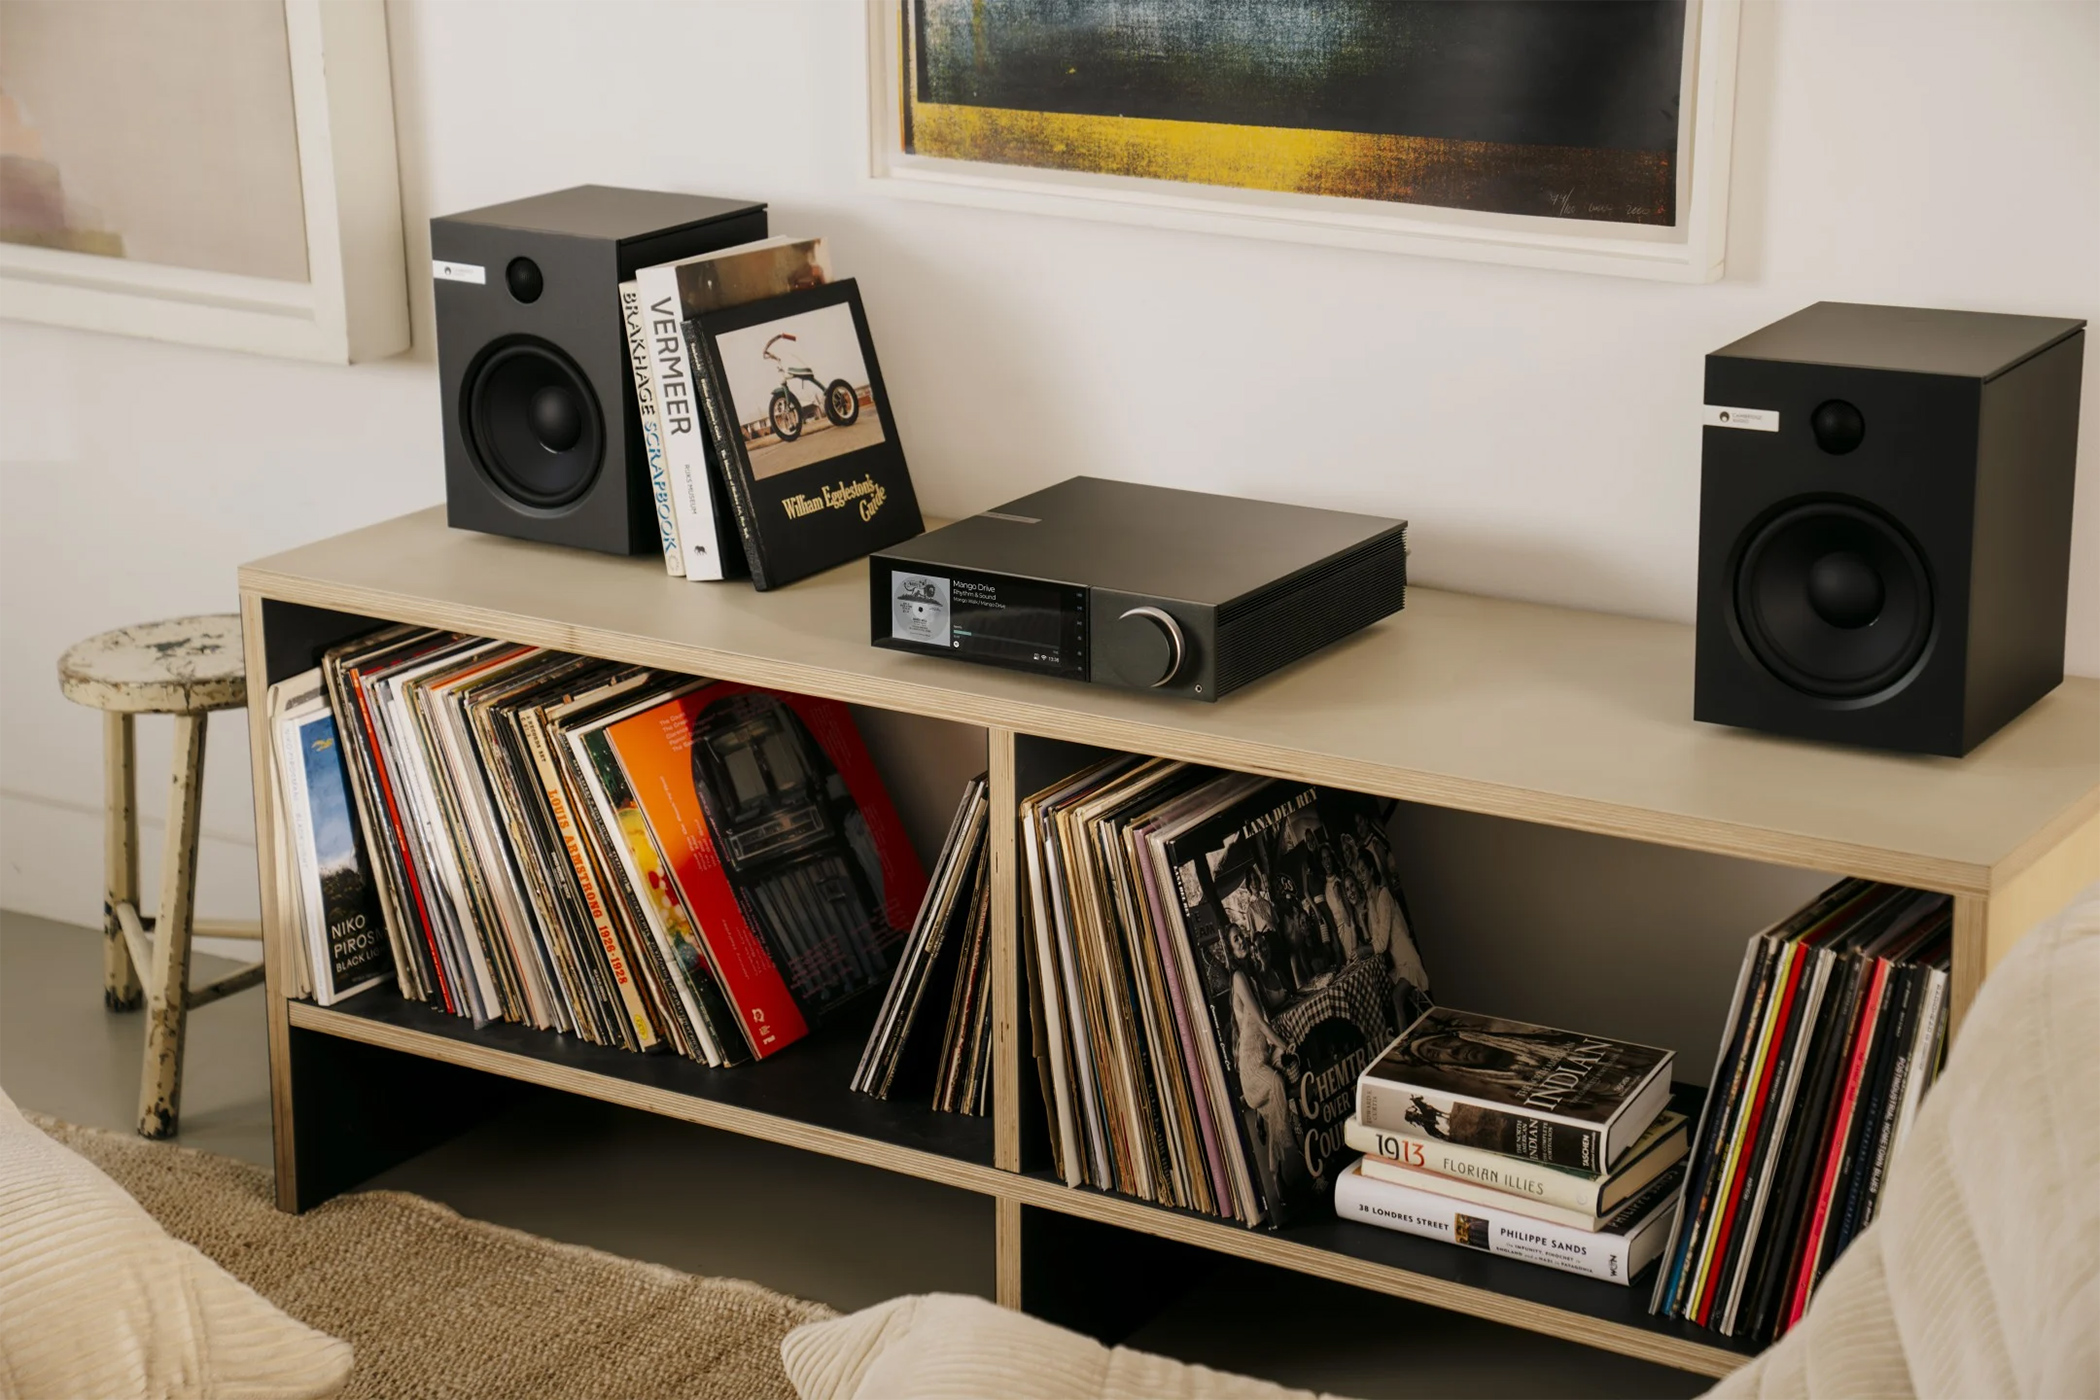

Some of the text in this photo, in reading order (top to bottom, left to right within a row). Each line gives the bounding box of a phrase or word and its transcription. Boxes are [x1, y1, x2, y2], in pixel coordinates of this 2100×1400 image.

[650, 296, 692, 435] VERMEER
[623, 293, 677, 553] BRAKHAGE SCRAPBOOK
[688, 484, 698, 514] MUSEUM
[782, 474, 875, 520] William Eggleston's
[859, 484, 887, 522] Guide
[953, 580, 996, 593] Mango Drive
[953, 589, 974, 600] Rhythm
[979, 592, 997, 601] Sound
[1242, 786, 1317, 839] LANA DEL REY
[546, 788, 570, 829] LOUIS
[561, 832, 605, 918] ARMSTRONG
[1173, 865, 1190, 917] LANA DEL REY
[331, 914, 366, 939] NIKO
[336, 947, 380, 973] BLACK LIG
[1524, 1038, 1613, 1111] INDIAN
[1884, 1055, 1906, 1121] POSTINDUSTRIAL
[1323, 1091, 1351, 1123] OVER
[1514, 1119, 1523, 1142] NORTH
[1518, 1123, 1530, 1153] AMERICAN
[1524, 1118, 1543, 1160] INDIAN
[1874, 1121, 1892, 1167] HOMETOWN
[1304, 1124, 1346, 1178] COU
[1376, 1134, 1425, 1167] 1913
[1579, 1133, 1592, 1166] TASCHEN
[1443, 1158, 1544, 1195] FLORIAN ILLIES
[1742, 1176, 1753, 1201] REQUIEM
[1868, 1166, 1882, 1193] BLUES
[1359, 1204, 1450, 1231] 38 LONDRES STREET
[1500, 1228, 1587, 1256] PHILIPPE SANDS
[1545, 1251, 1574, 1261] PINOCHET
[1496, 1246, 1523, 1257] ENGLAND
[1561, 1262, 1593, 1273] PATAGONIA
